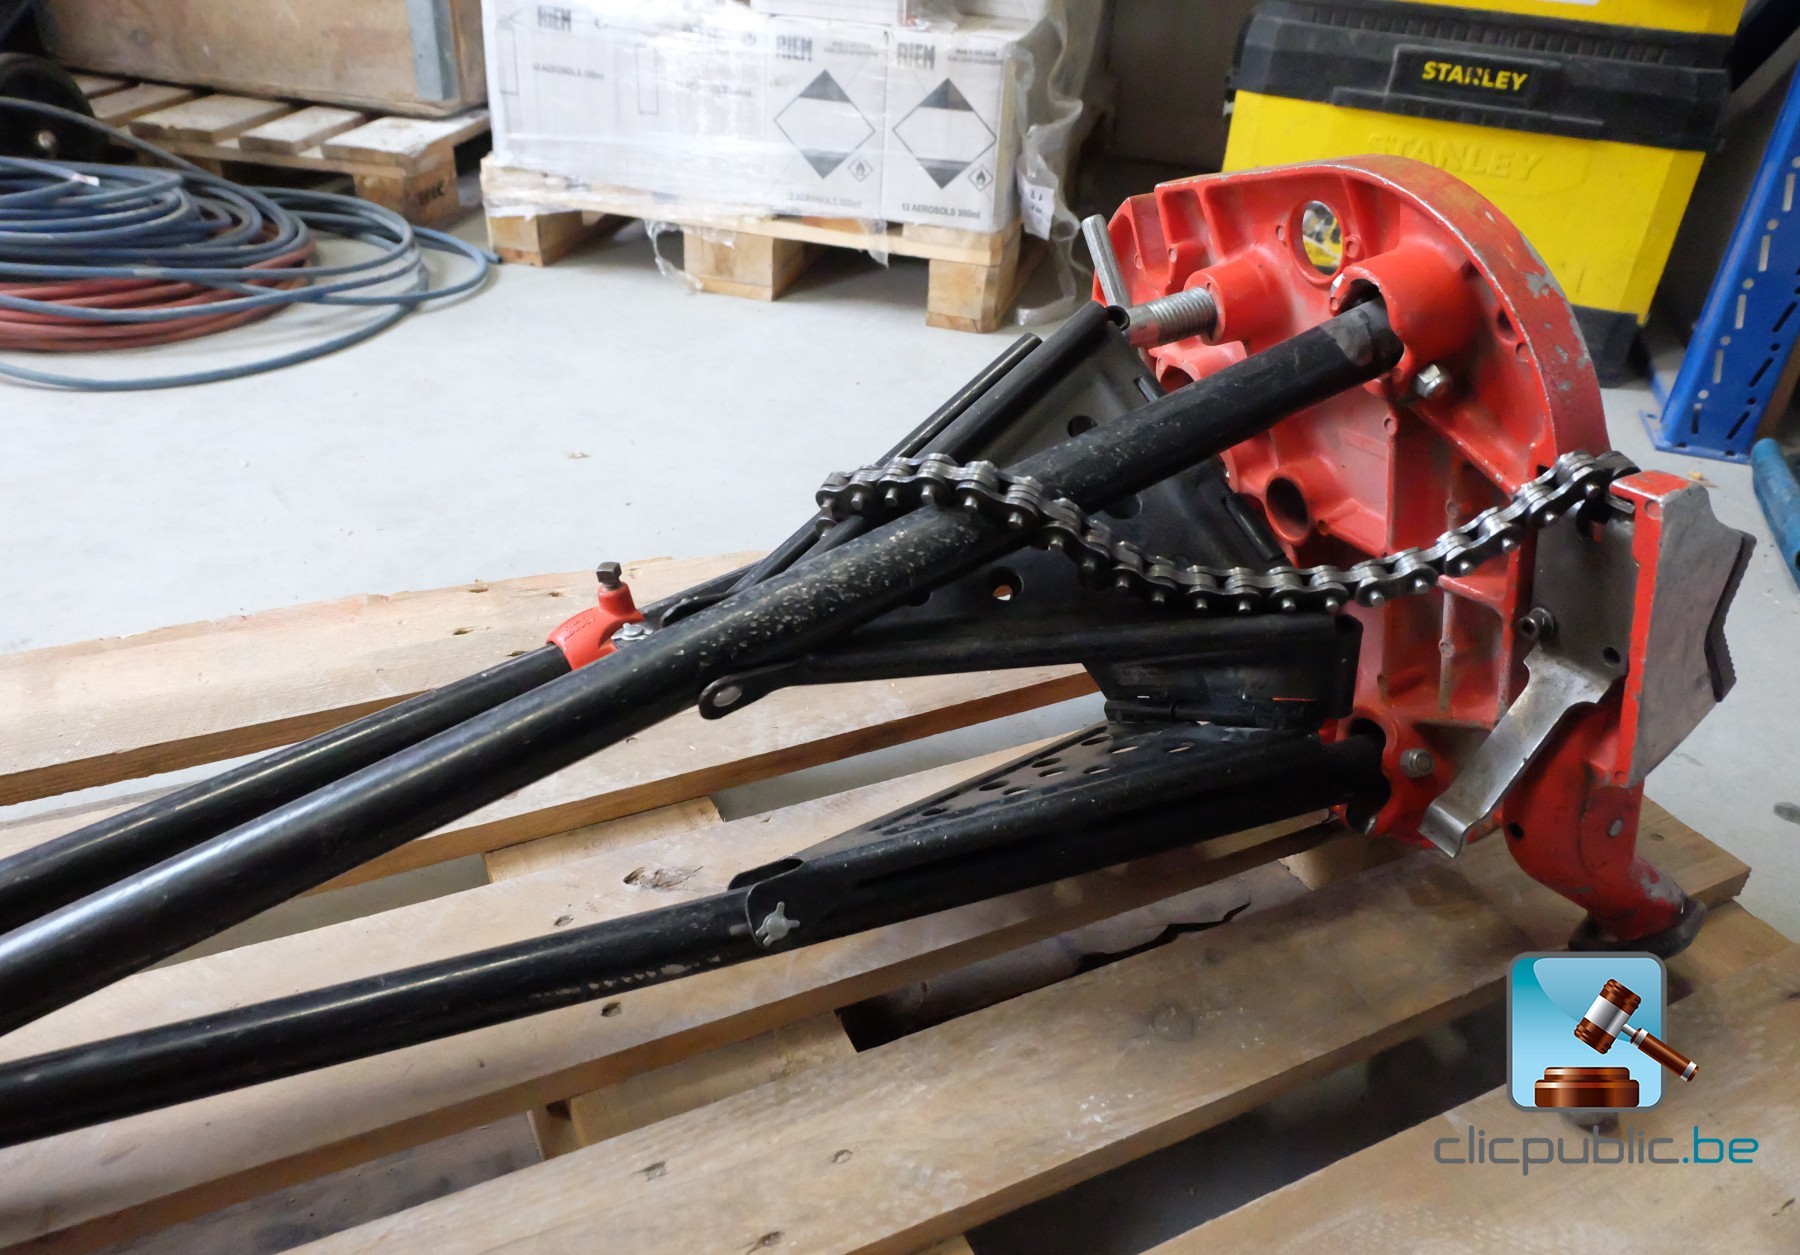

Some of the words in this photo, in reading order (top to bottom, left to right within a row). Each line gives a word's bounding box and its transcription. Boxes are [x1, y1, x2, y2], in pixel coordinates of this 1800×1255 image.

[1421, 60, 1528, 92] STANLEY
[1369, 132, 1545, 181] STANLEY
[911, 203, 956, 217] AEROSOLS
